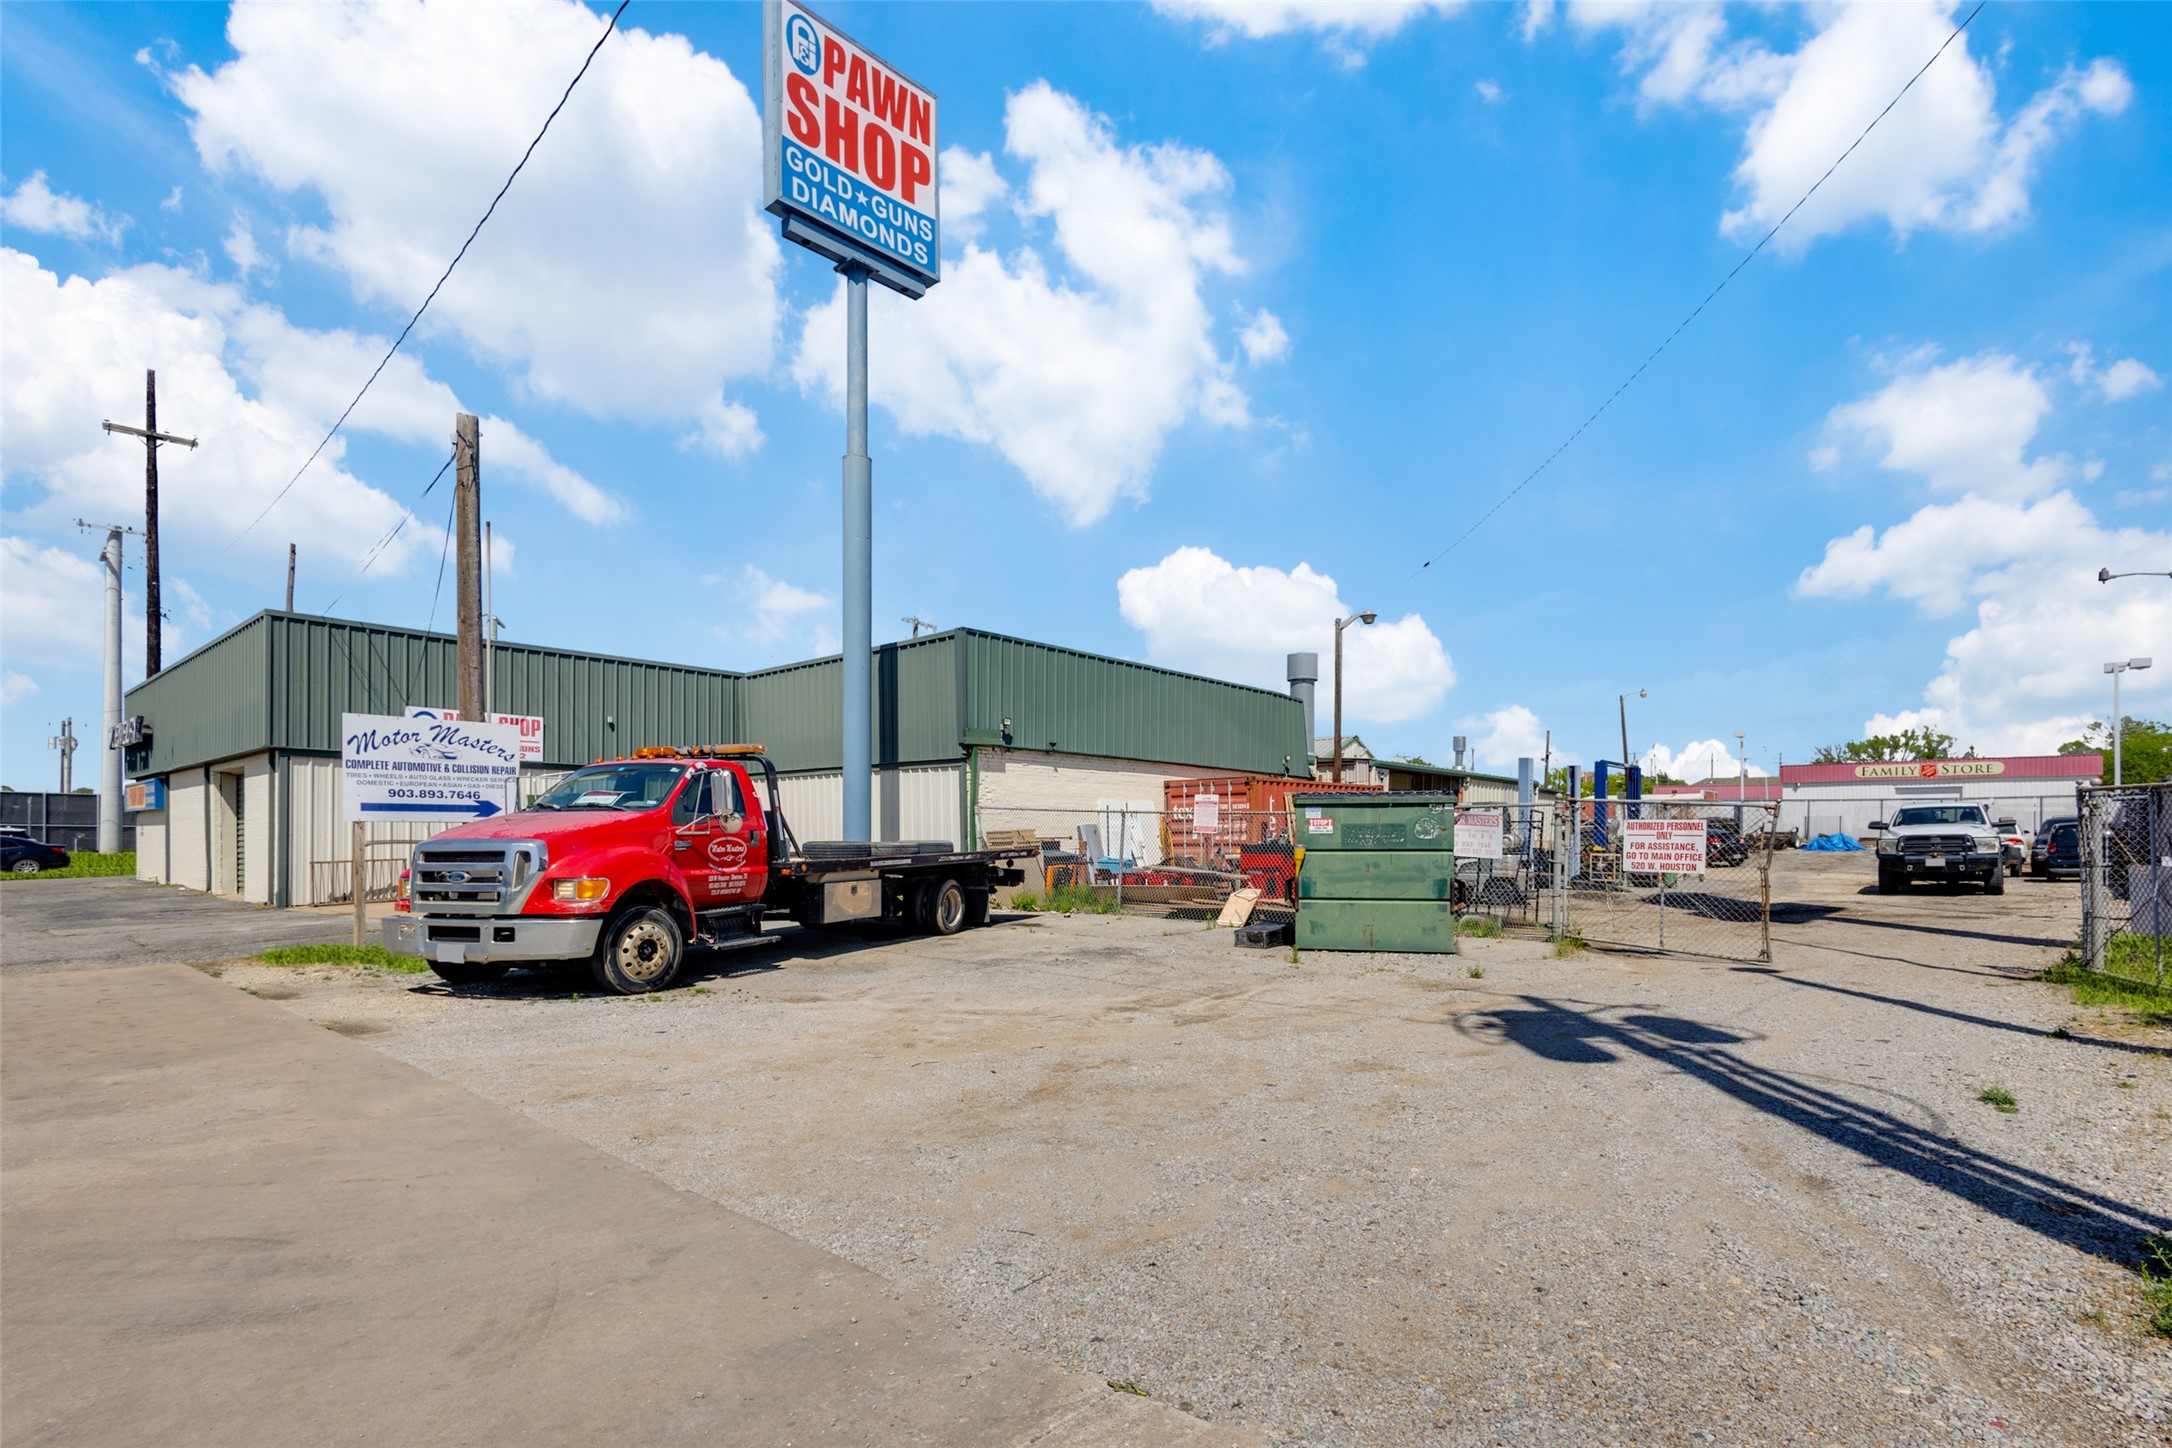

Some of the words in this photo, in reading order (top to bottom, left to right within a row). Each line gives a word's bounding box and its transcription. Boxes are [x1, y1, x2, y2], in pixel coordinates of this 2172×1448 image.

[823, 34, 931, 147] PAWN
[786, 72, 931, 205] SHOP
[786, 147, 852, 197] GOLD
[872, 197, 933, 242] GUNS
[792, 178, 928, 265] DIAMONDS
[347, 729, 421, 755] Motor
[429, 724, 516, 762] Masters
[345, 759, 389, 770] COMPLETE
[392, 761, 442, 773] AUTOMOTIVE
[444, 763, 450, 773] &
[452, 764, 490, 774] COLLISION
[491, 765, 517, 776] REPAIR
[1862, 765, 1917, 776] FAMILY
[1941, 763, 1994, 774] STORE
[388, 788, 481, 800] 903.893.7646
[1313, 819, 1329, 827] STOP
[1467, 815, 1498, 826] MASTERS
[1626, 822, 1665, 830] AUTHORIZED
[1666, 822, 1705, 831] PERSONNEL
[1656, 831, 1673, 840] ONLY
[1630, 842, 1646, 850] FOR
[1647, 842, 1699, 852] ASSISTANCE,
[1626, 852, 1637, 860] GO
[1639, 852, 1649, 860] TO
[1651, 852, 1672, 860] MAIN
[1674, 852, 1703, 861] OFFICE
[1631, 862, 1646, 870] 520
[1647, 862, 1657, 870] W.
[1659, 863, 1697, 871] HOUSTON
